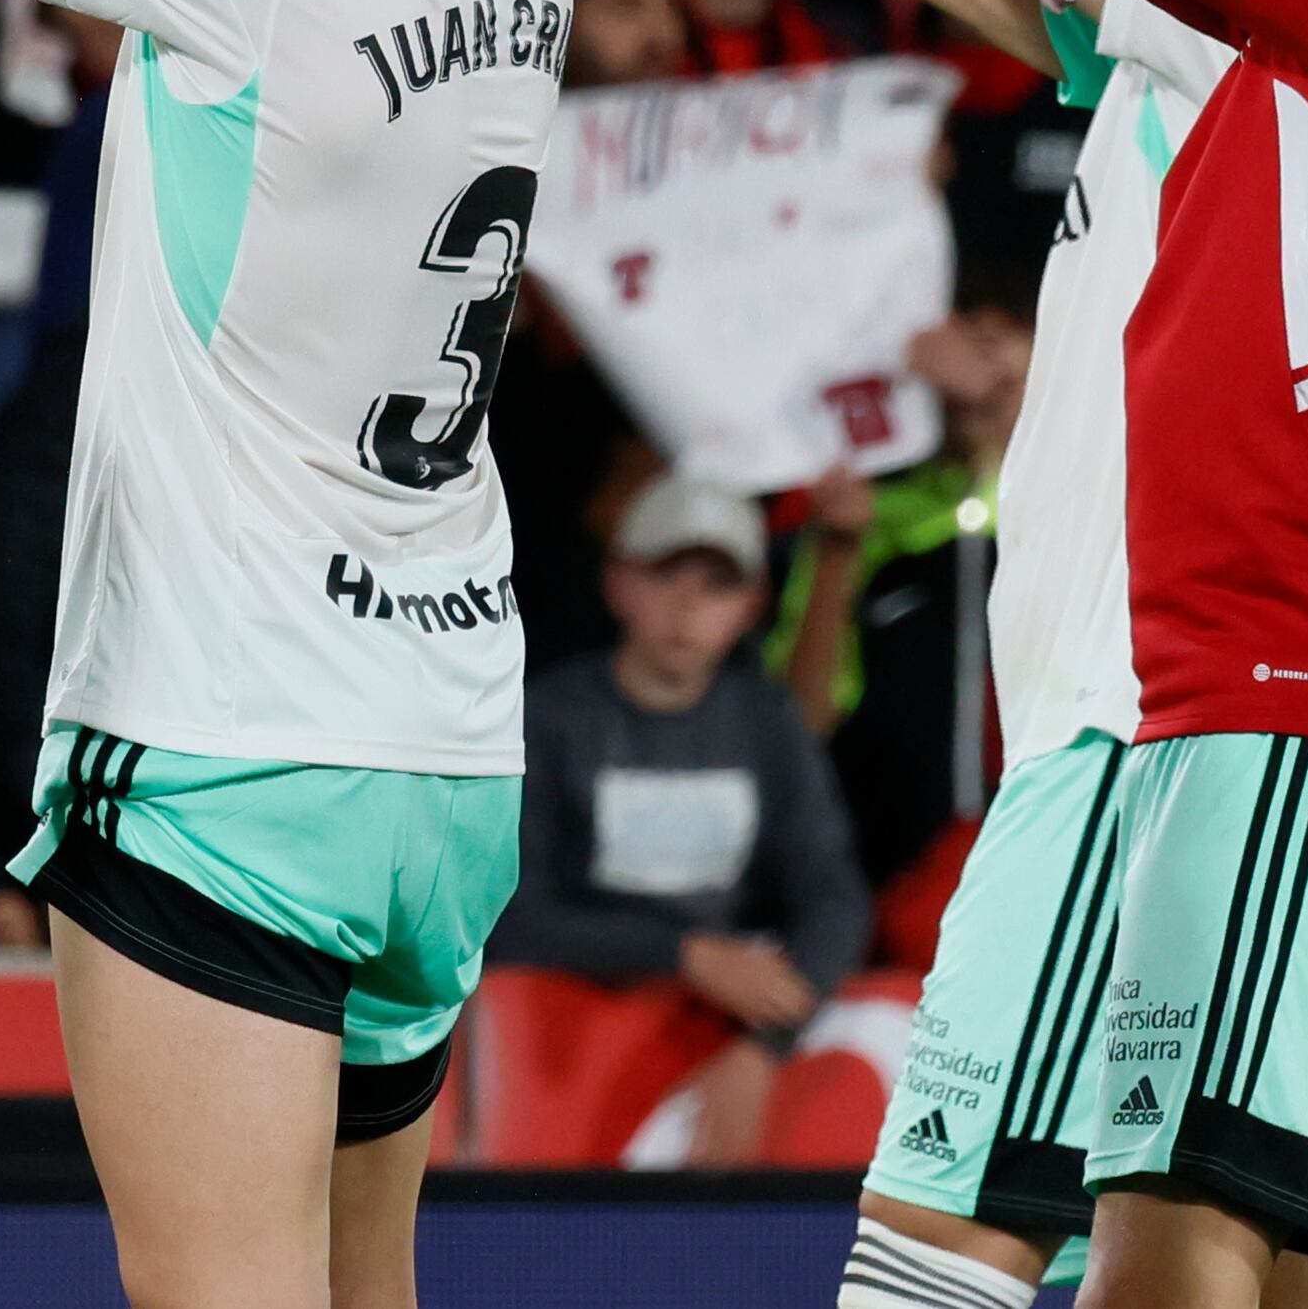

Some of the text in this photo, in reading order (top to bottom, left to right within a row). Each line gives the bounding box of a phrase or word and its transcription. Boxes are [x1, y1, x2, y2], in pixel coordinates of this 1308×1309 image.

[356, 165, 538, 492] 3
[1111, 1108, 1165, 1126] adidas
[898, 1134, 958, 1163] adidas
